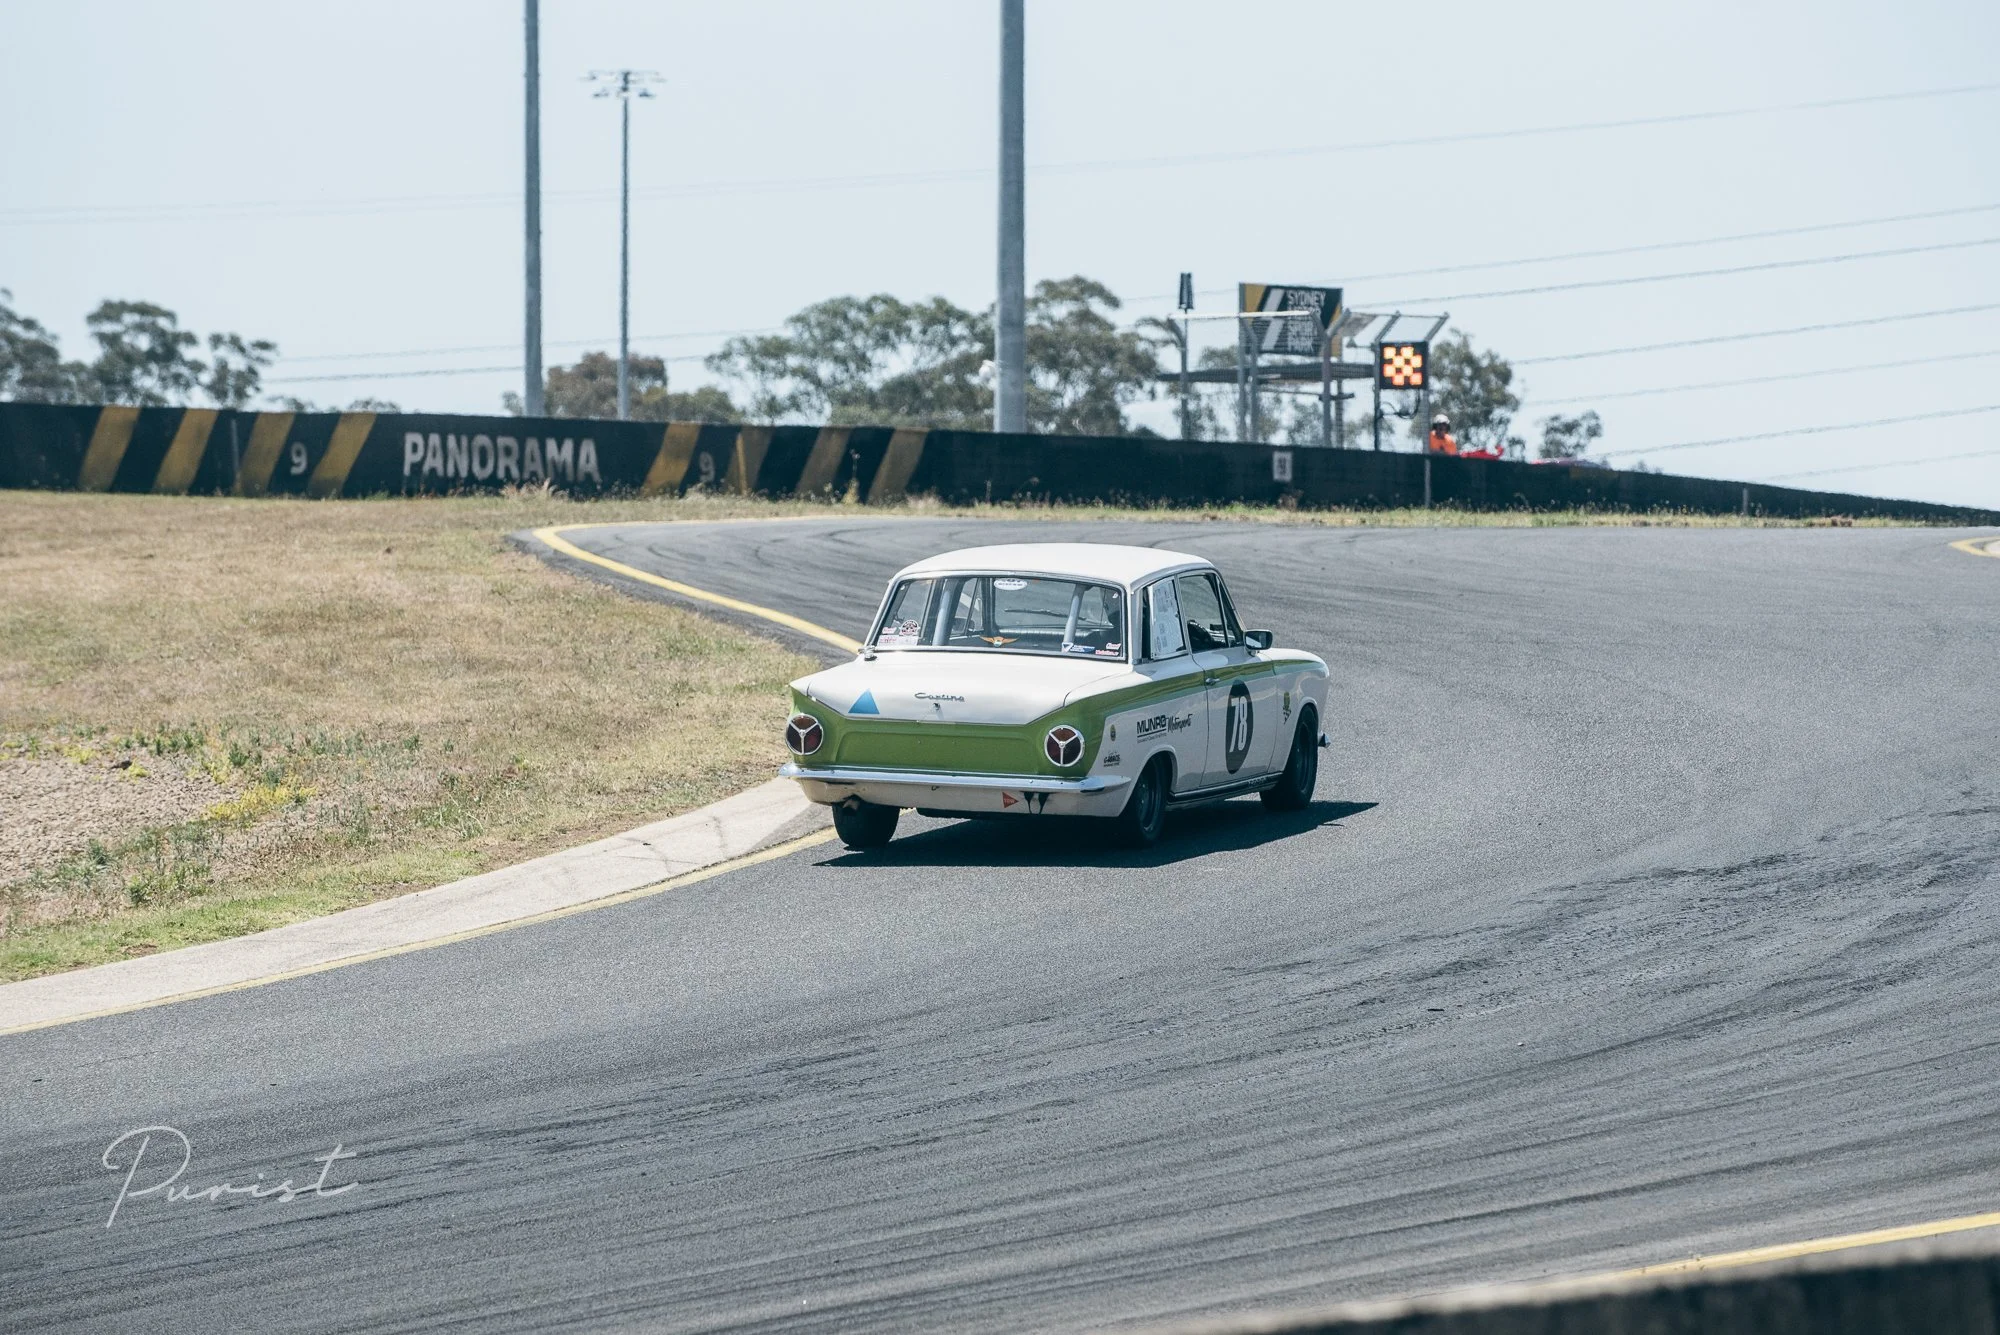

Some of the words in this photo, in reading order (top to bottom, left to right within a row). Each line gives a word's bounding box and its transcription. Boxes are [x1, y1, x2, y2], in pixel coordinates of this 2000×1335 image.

[1287, 289, 1327, 308] SYDNEY
[290, 442, 308, 476] 9
[403, 431, 600, 483] PANORAMA
[699, 451, 716, 483] 9
[914, 692, 966, 703] Cortina
[1136, 714, 1167, 735] MUNRO
[1228, 695, 1248, 753] 78
